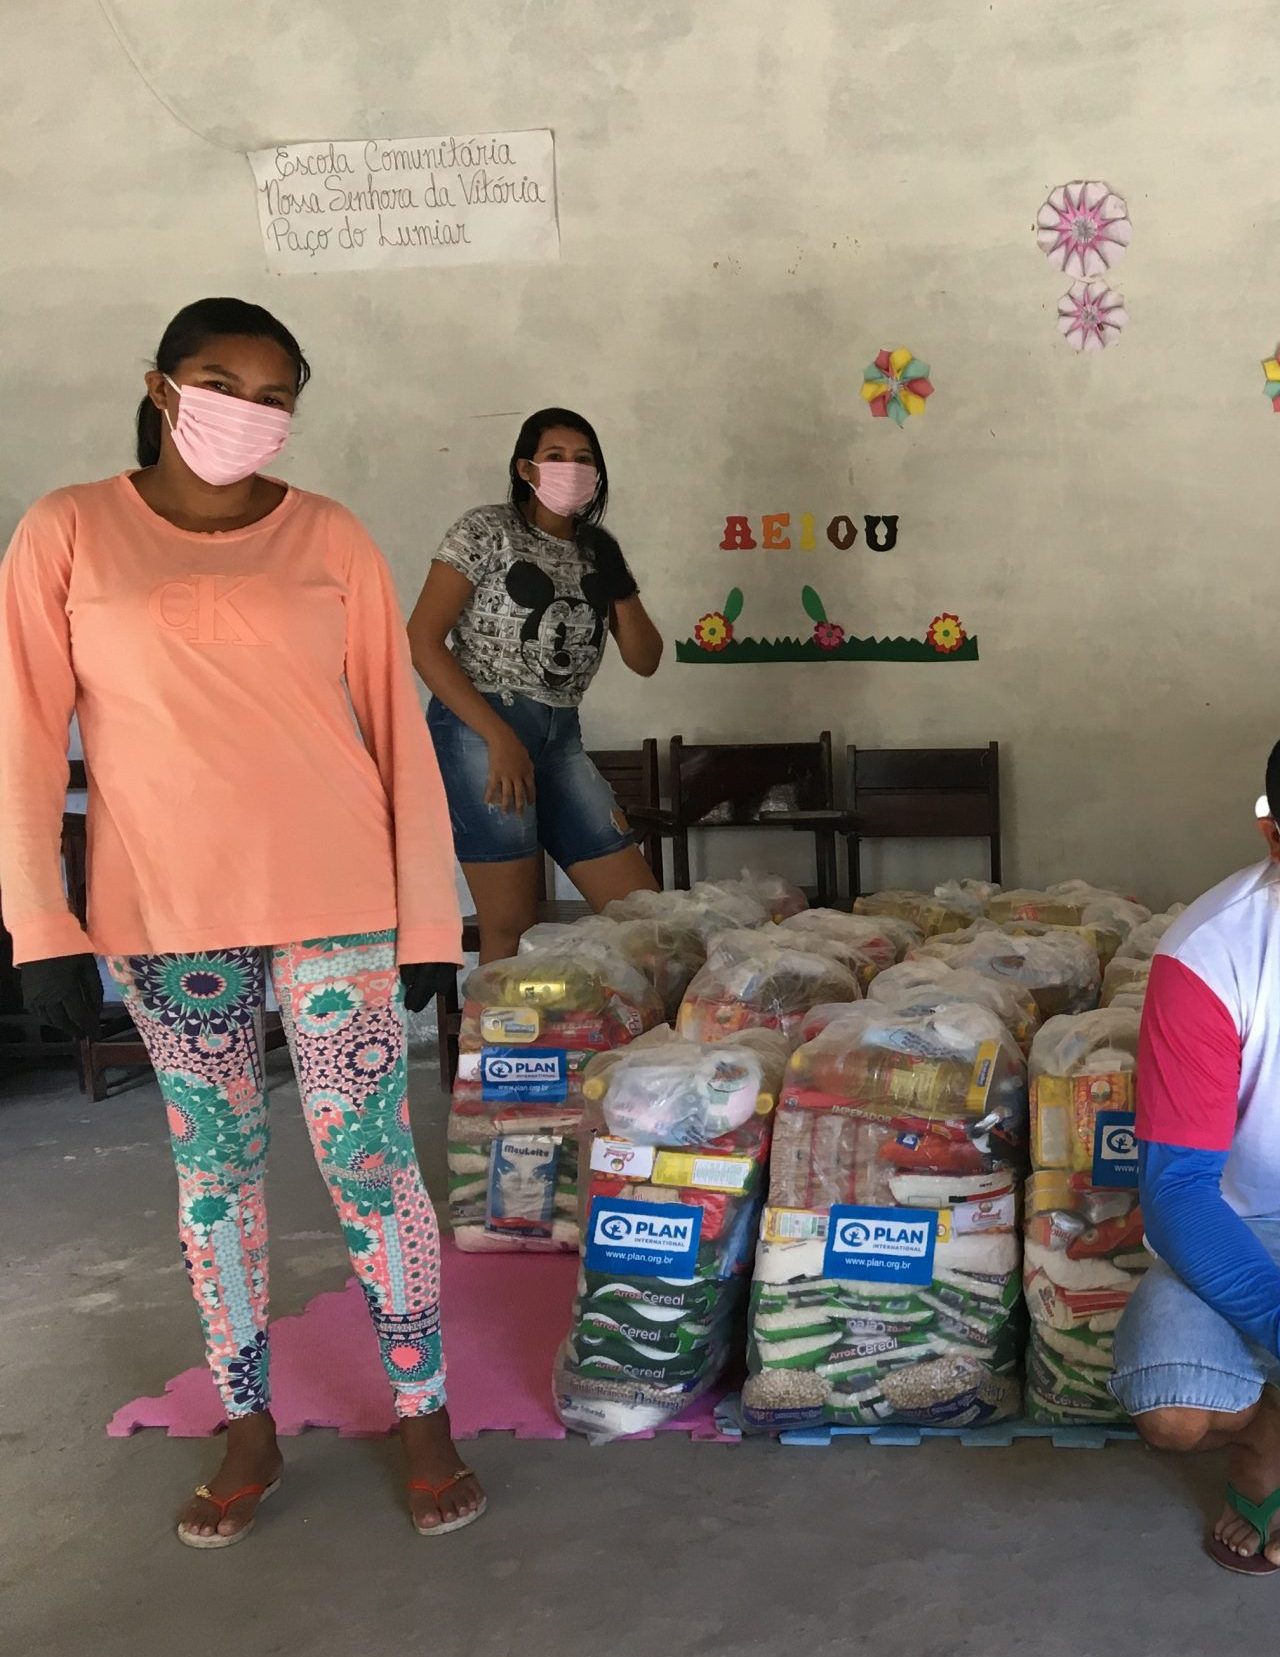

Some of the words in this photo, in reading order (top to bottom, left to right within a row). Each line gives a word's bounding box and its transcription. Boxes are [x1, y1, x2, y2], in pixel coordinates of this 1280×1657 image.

[275, 144, 354, 180] Escola
[364, 137, 516, 172] Comunitária
[260, 179, 325, 215] Nossa
[324, 174, 418, 211] Senhora
[424, 172, 456, 208] da
[458, 169, 545, 205] Vitória
[267, 217, 332, 256] Paço
[339, 215, 367, 249] do
[378, 214, 471, 247] Lumiar
[149, 574, 272, 646] CK
[515, 1062, 555, 1073] PLAN
[636, 1221, 687, 1239] PLAN
[873, 1227, 923, 1244] PLAN
[605, 1250, 673, 1264] www.plan.org.br
[845, 1258, 911, 1270] www.plan.org.br
[641, 1291, 684, 1305] Cereal
[619, 1324, 661, 1341] Cereal
[857, 1338, 898, 1356] Cereal
[623, 1365, 665, 1379] Cereal
